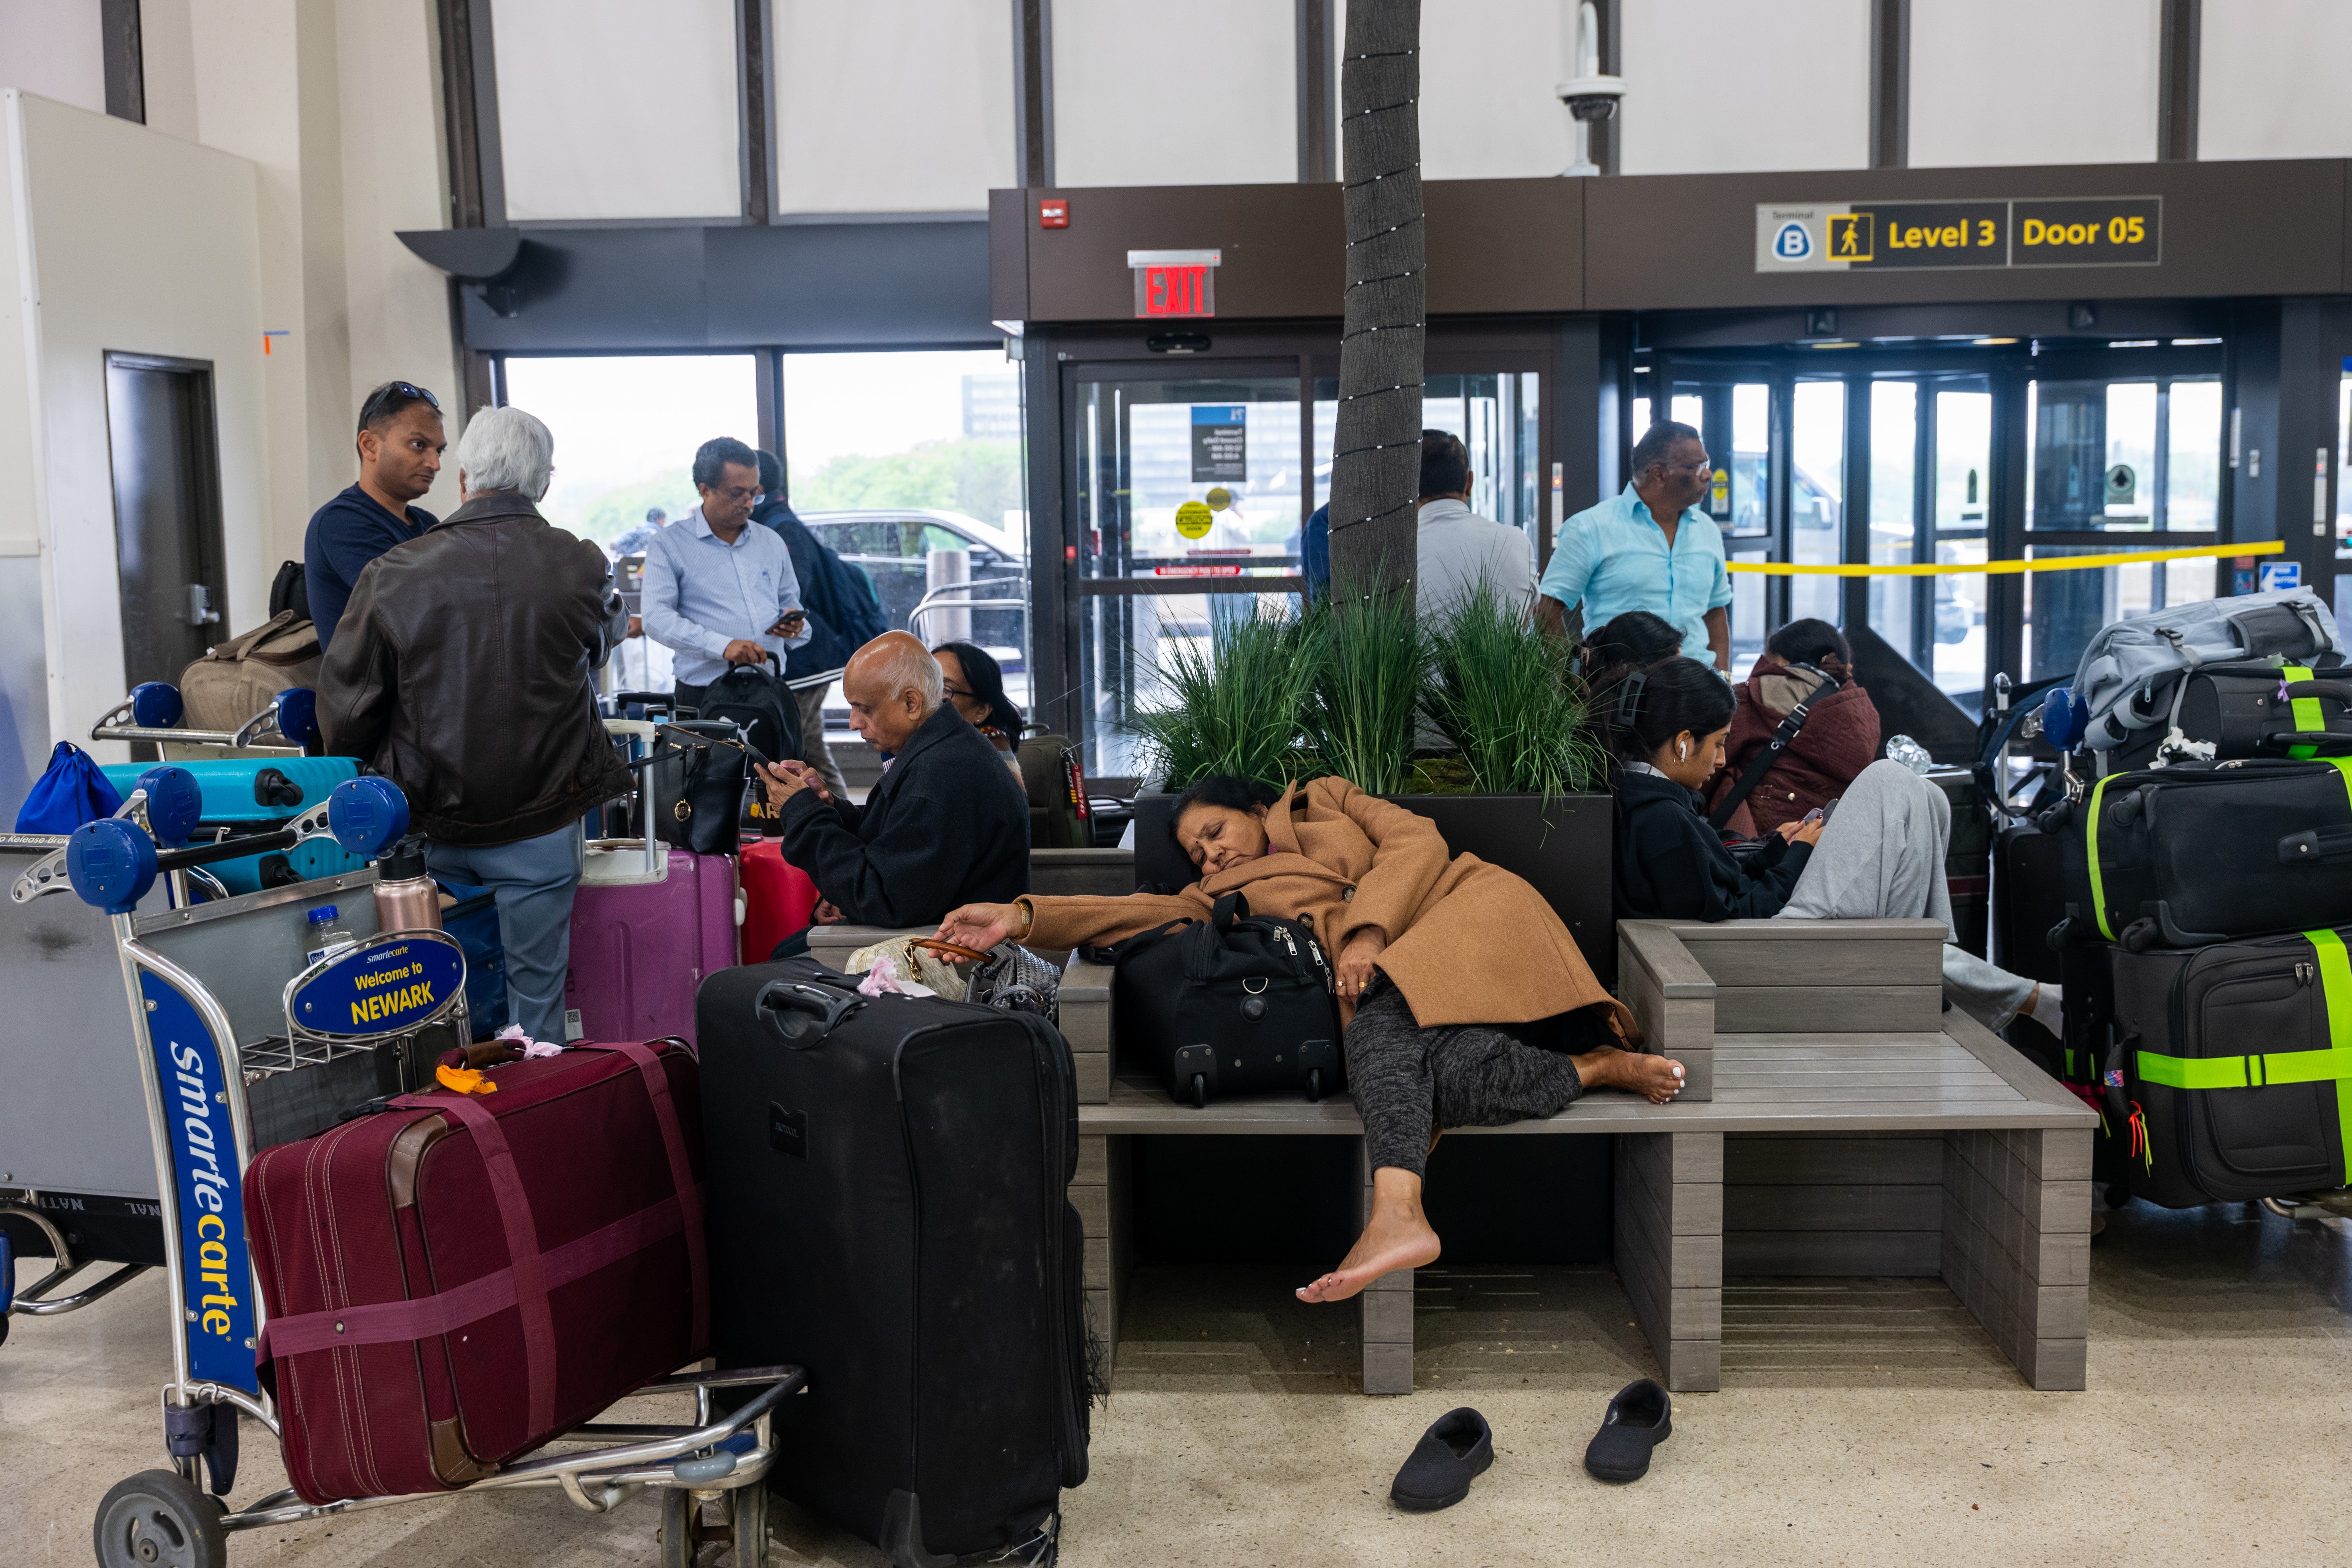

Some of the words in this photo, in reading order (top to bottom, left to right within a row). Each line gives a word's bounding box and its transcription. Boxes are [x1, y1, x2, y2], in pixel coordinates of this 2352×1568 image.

[1772, 211, 1814, 221] Terminal
[1783, 230, 1804, 255] B
[1889, 219, 1968, 249] Level
[1977, 220, 1996, 247] 3
[2023, 219, 2100, 246] Door
[2107, 216, 2145, 244] 05
[1146, 266, 1207, 313] EXIT
[1066, 762, 1074, 789] PILOT
[311, 953, 324, 963] Naked
[367, 945, 409, 963] smartecarte
[354, 968, 409, 990] Welcome
[412, 962, 423, 974] to
[351, 980, 435, 1025] NEWARK
